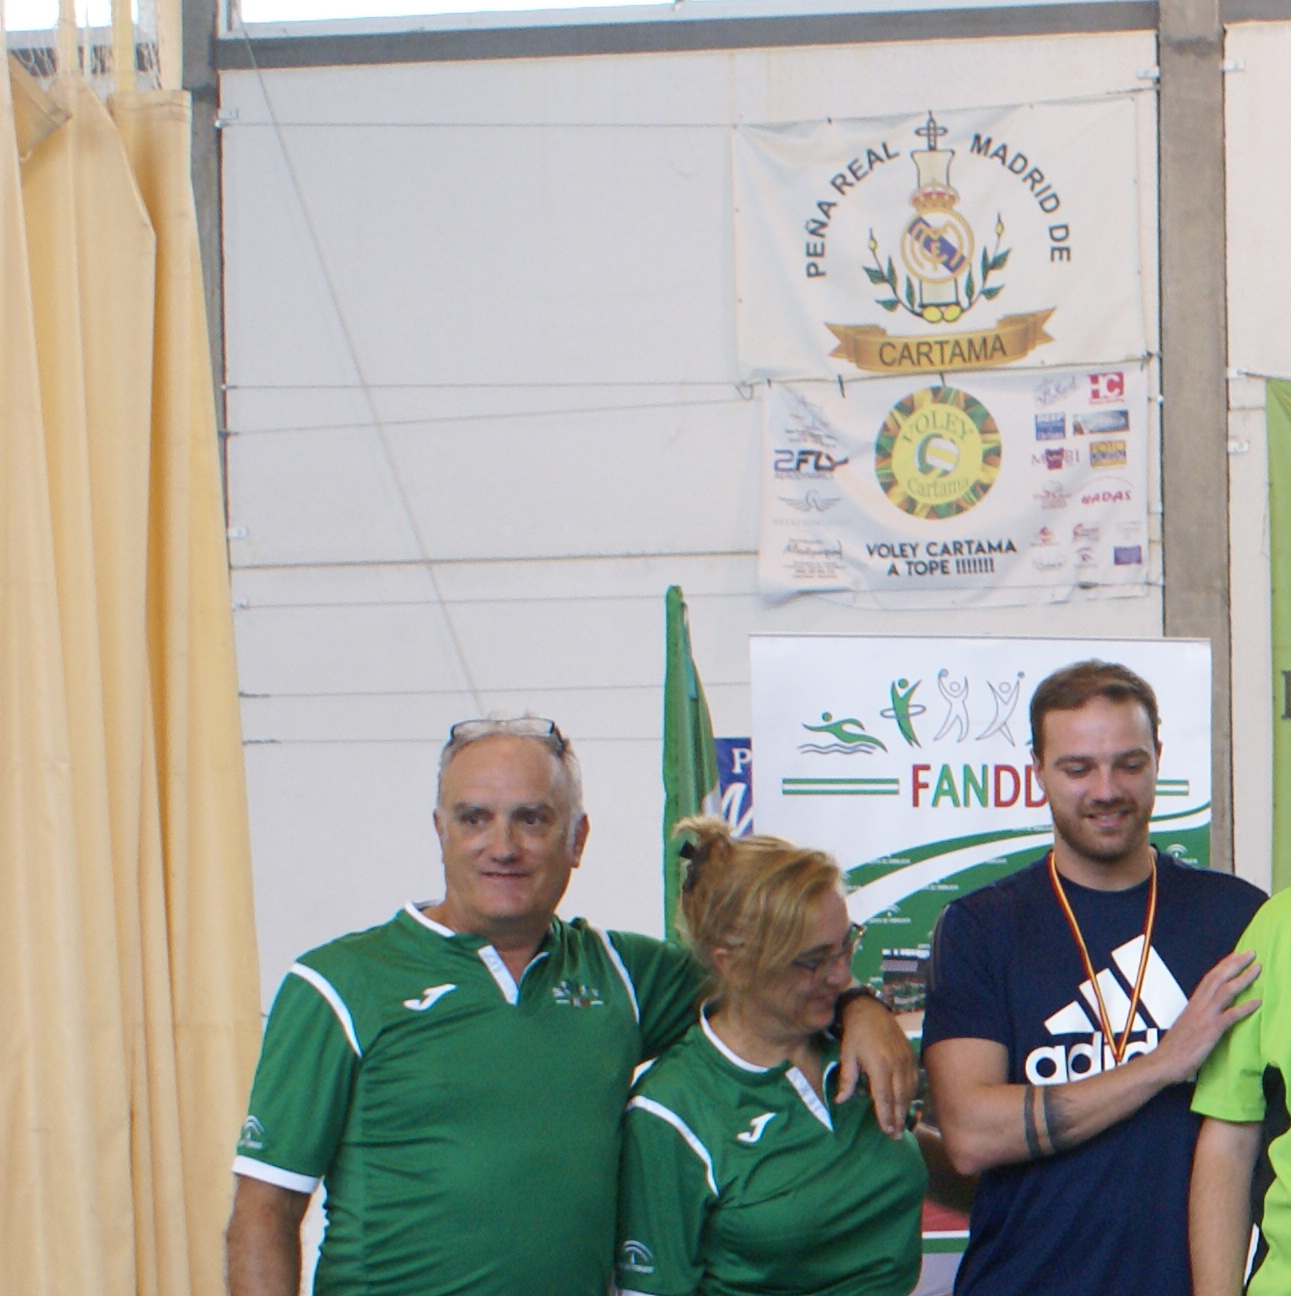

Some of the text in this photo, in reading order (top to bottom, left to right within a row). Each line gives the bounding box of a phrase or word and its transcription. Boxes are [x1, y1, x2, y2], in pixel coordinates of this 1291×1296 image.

[805, 132, 1072, 279] PEÑA REAL MADRID DE
[877, 334, 1008, 367] CARTAMA
[902, 410, 974, 443] VOLEY
[906, 477, 971, 498] Cartama
[866, 542, 919, 559] VOLEY
[926, 540, 1018, 557] CARTAMA
[887, 560, 899, 576] A
[906, 559, 951, 576] TOPE
[911, 764, 1049, 809] FANDD
[1025, 1028, 1158, 1086] adid
